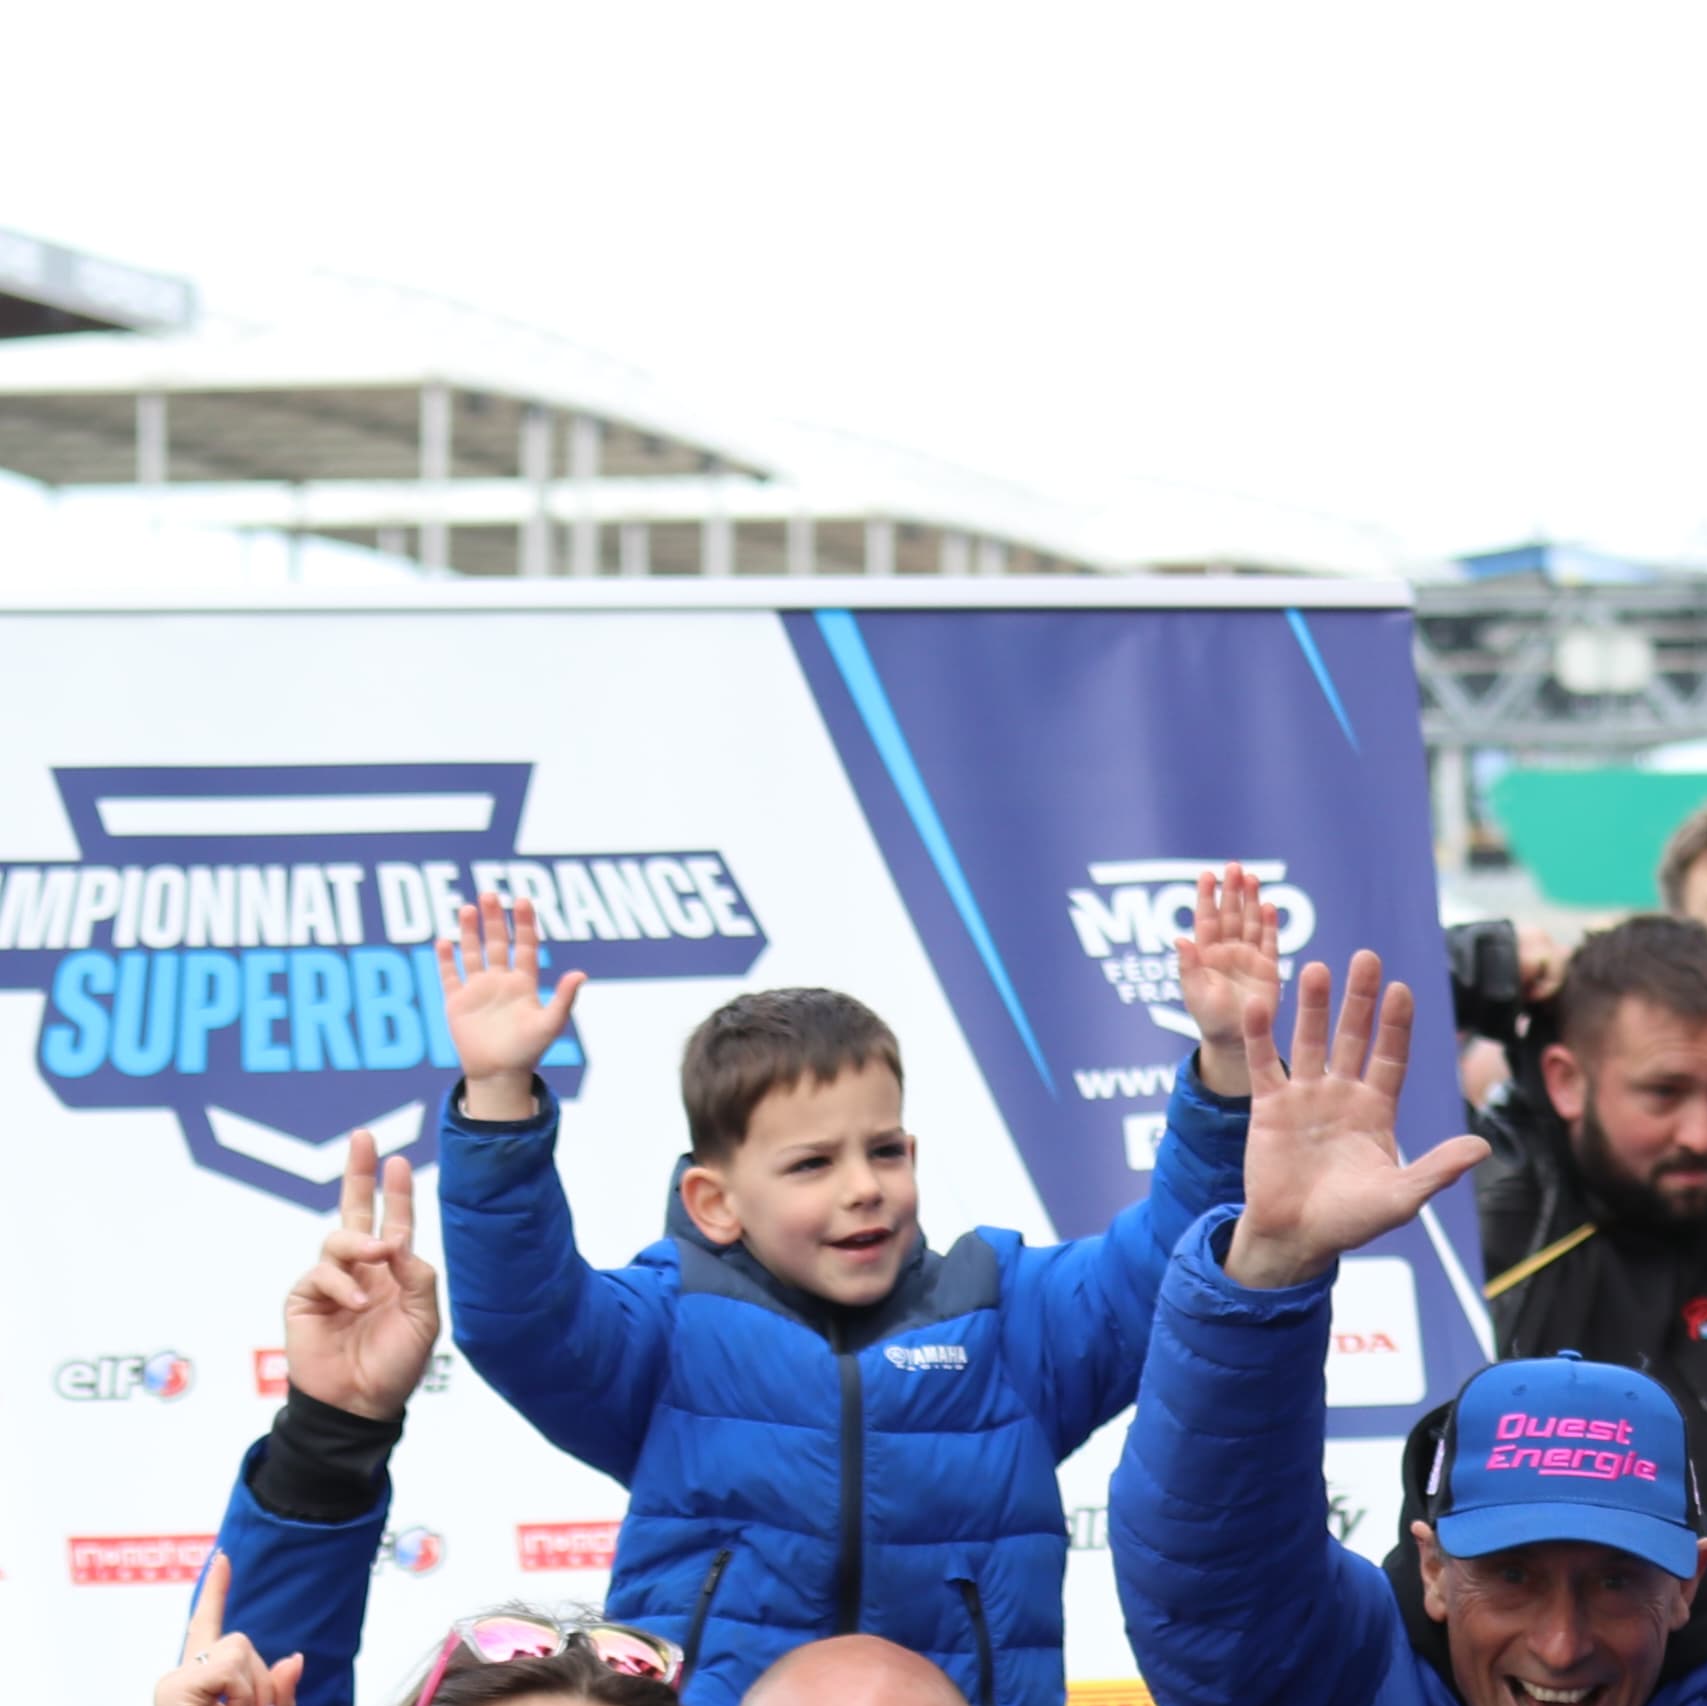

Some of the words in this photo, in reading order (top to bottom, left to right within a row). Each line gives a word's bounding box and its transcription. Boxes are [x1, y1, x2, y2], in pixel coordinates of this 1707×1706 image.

[0, 864, 365, 949] MPIONNAT
[376, 860, 463, 944] DE
[1067, 884, 1316, 957] MOO
[42, 946, 582, 1077] SUPERBI
[56, 1354, 146, 1399] elf
